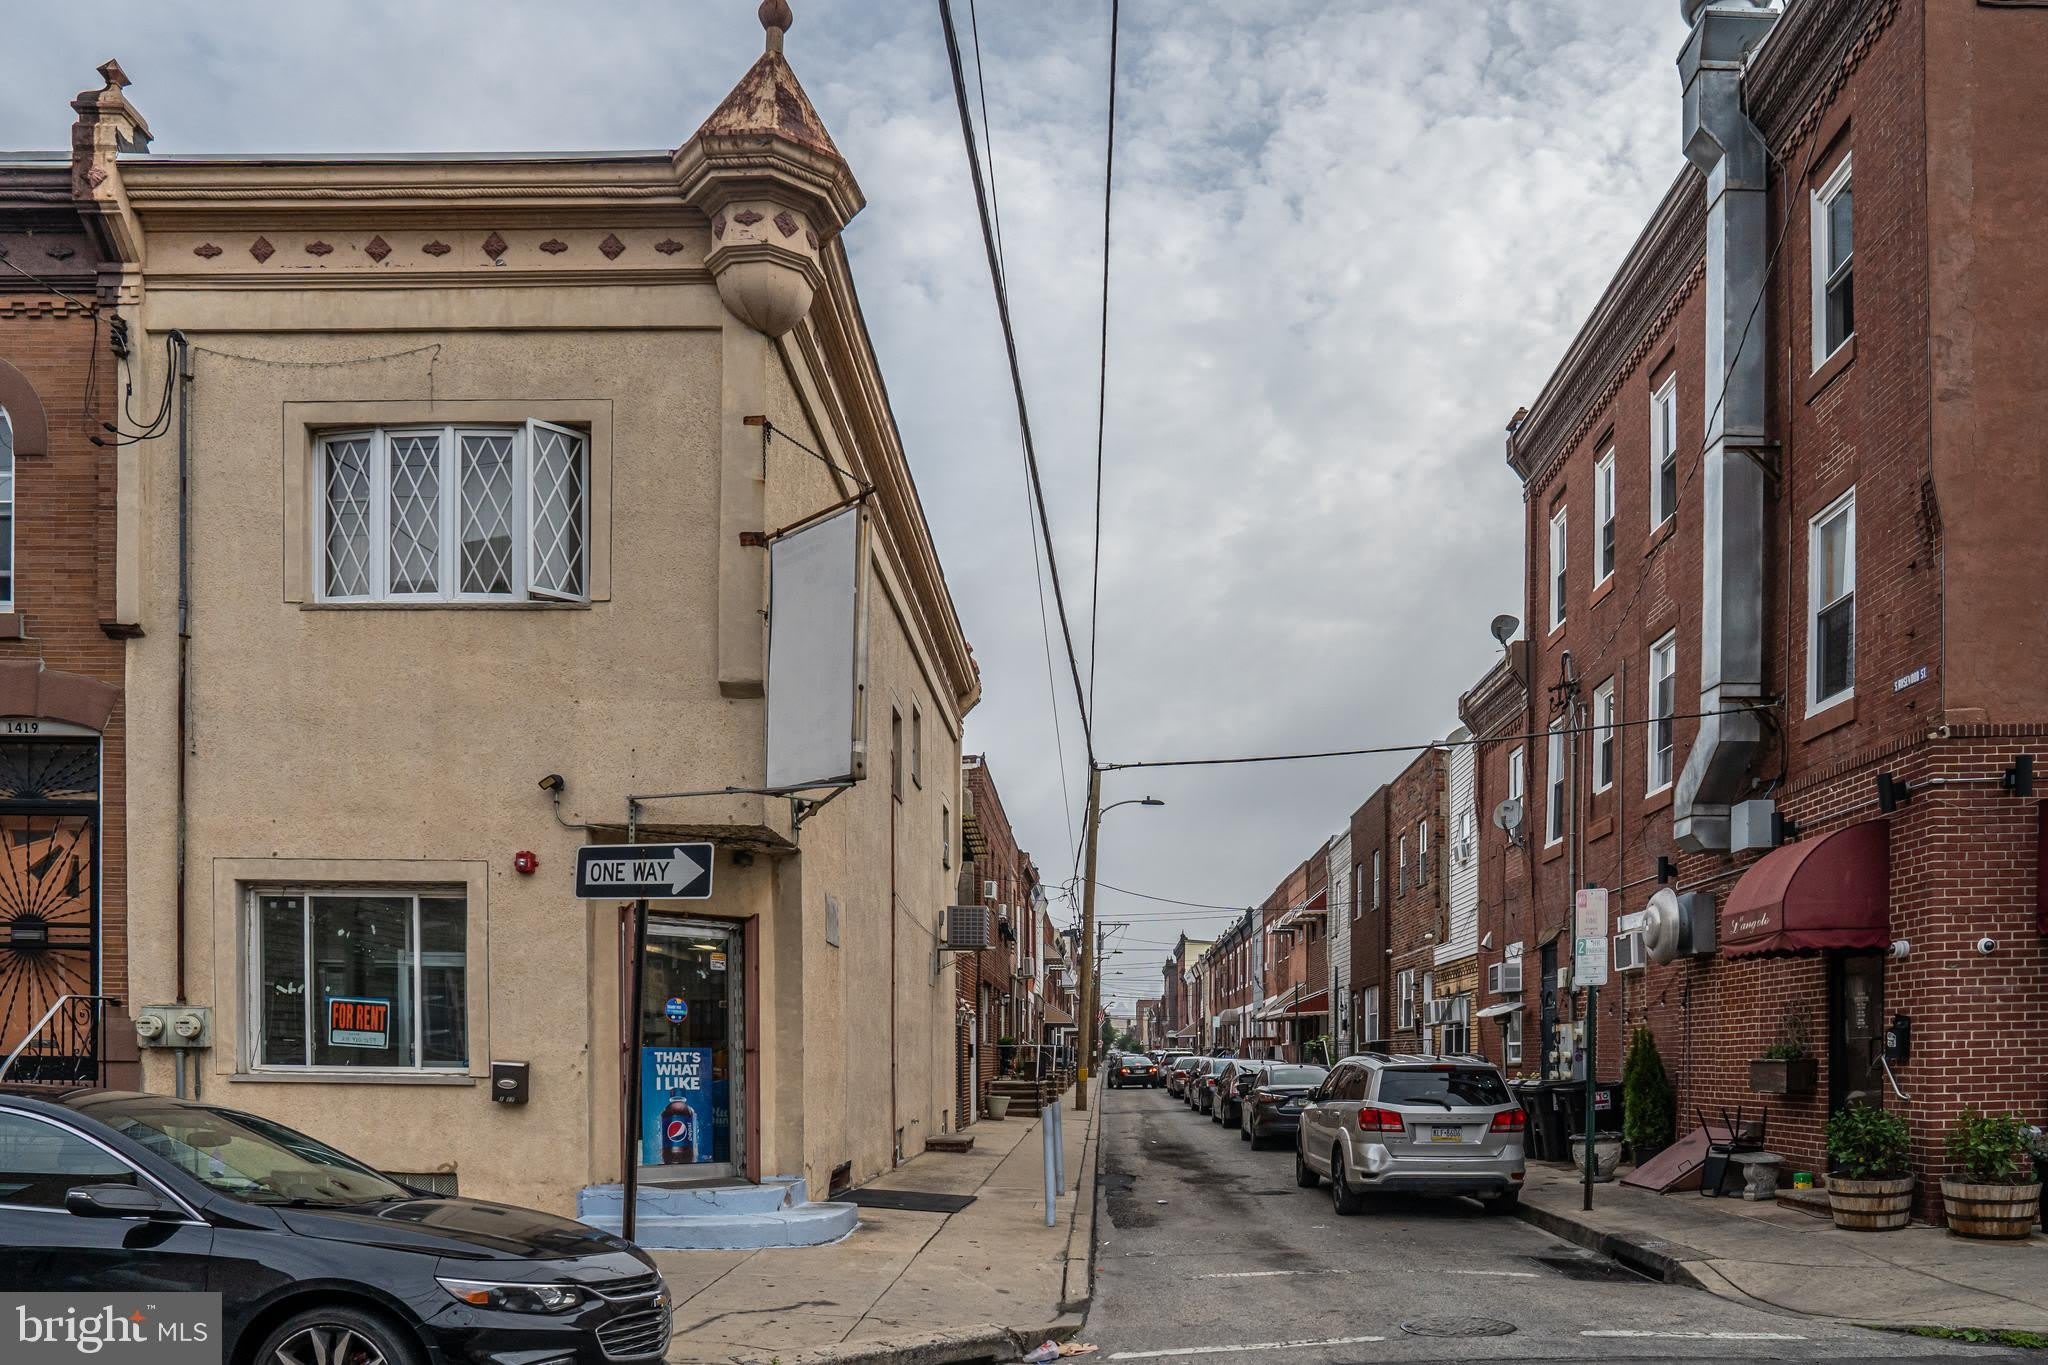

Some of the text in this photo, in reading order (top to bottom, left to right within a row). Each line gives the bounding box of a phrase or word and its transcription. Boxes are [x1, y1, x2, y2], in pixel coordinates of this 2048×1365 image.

[8, 722, 38, 733] 1419
[590, 861, 670, 882] ONE WAY
[1578, 941, 1585, 954] 2
[332, 1002, 386, 1031] FOR RENT
[654, 1052, 701, 1063] THAT'S
[656, 1064, 699, 1075] WHAT
[656, 1077, 700, 1090] I LIKE
